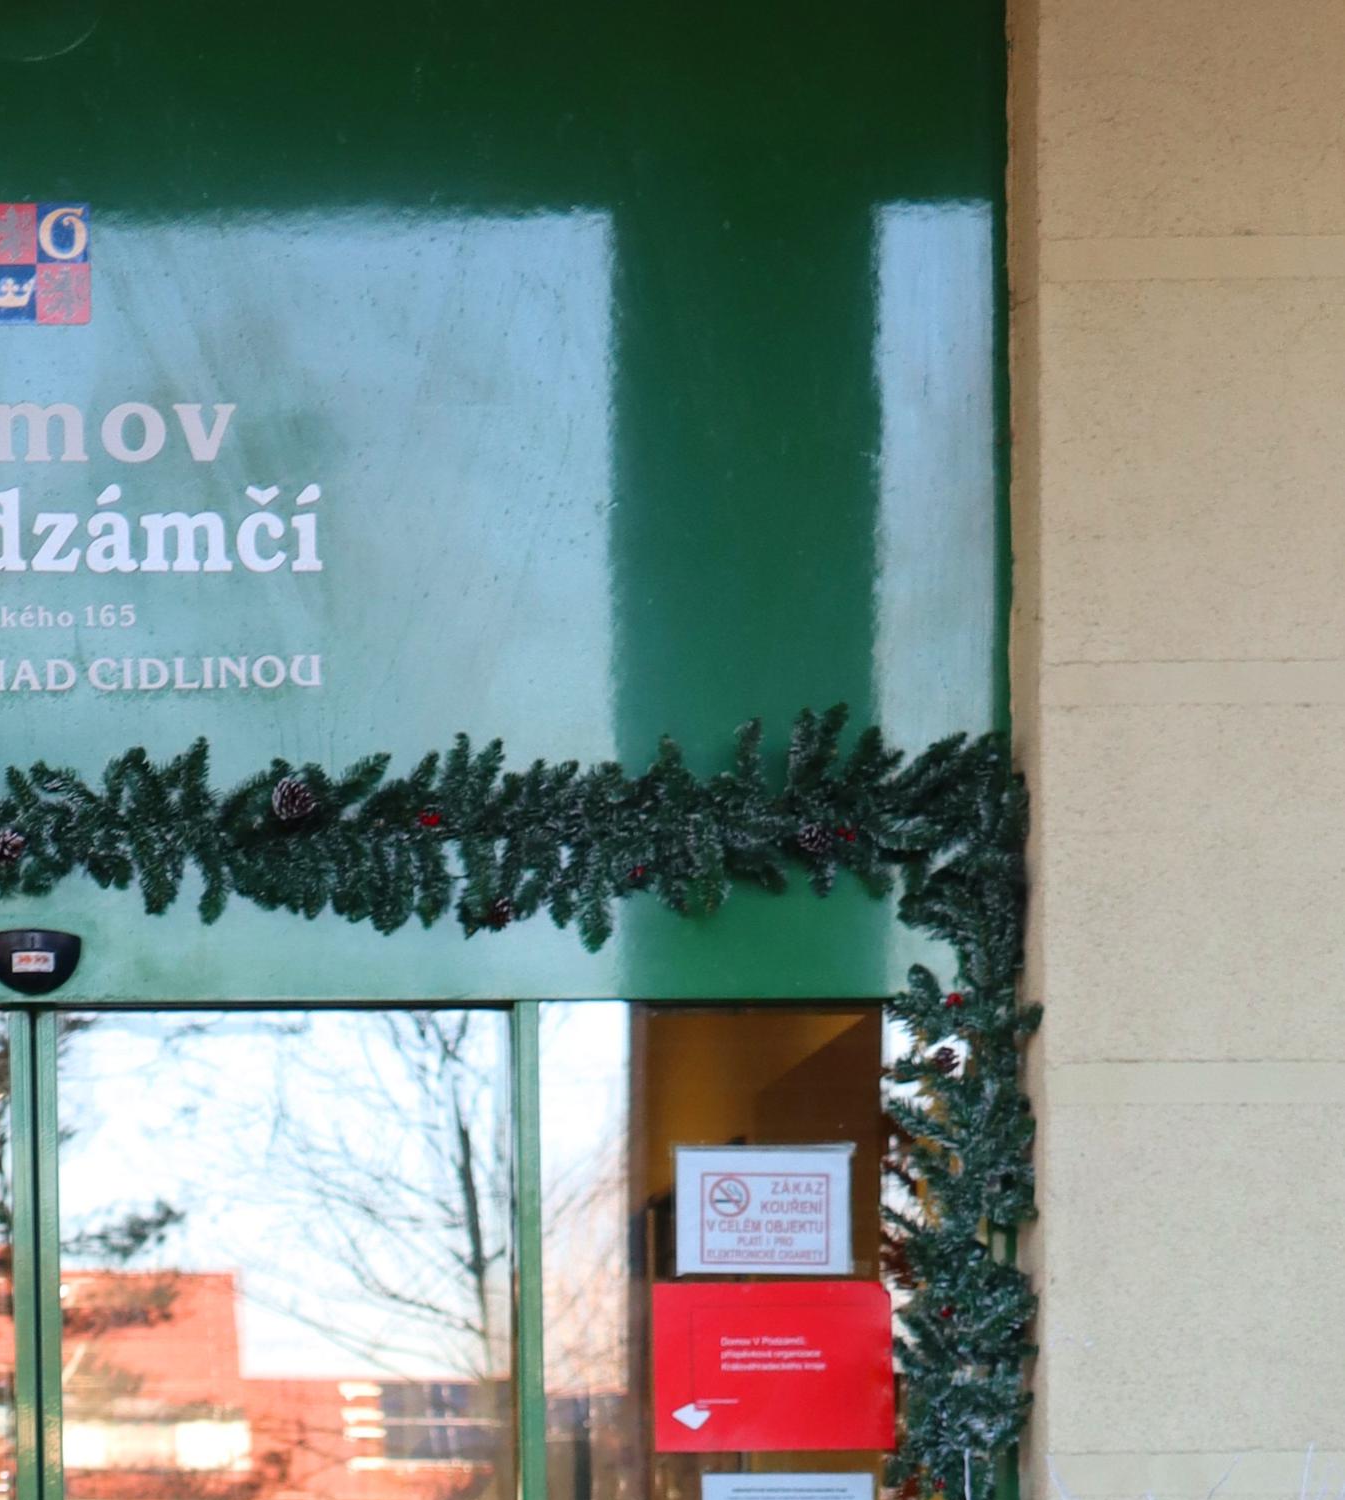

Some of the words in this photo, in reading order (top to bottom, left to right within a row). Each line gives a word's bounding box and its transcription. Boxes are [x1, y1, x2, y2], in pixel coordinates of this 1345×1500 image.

[85, 604, 137, 627] 165
[88, 654, 323, 690] CIDLINOU
[771, 1180, 824, 1195] ZÁKAZ
[760, 1199, 823, 1214] KOUŘENÍ
[707, 1221, 715, 1232] V
[718, 1218, 761, 1233] CELÉM
[765, 1220, 823, 1233] OBJEKTU
